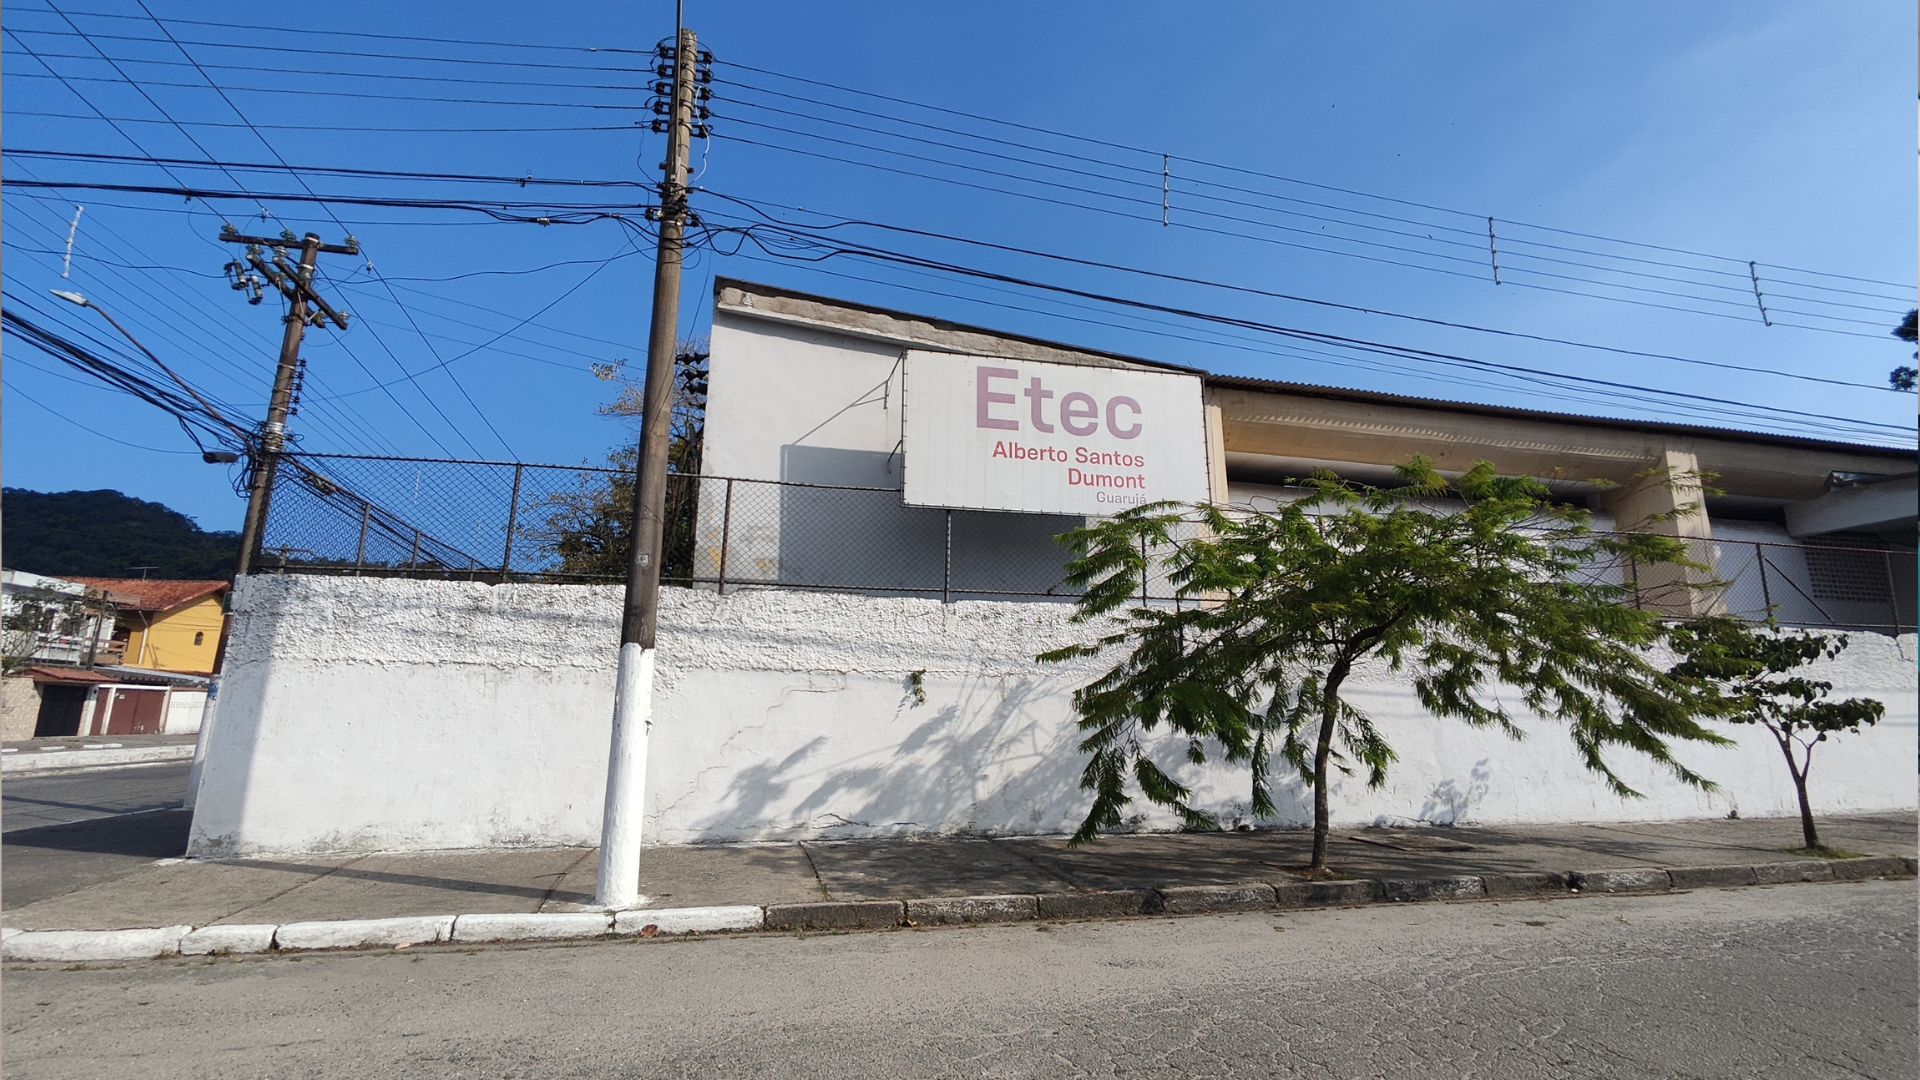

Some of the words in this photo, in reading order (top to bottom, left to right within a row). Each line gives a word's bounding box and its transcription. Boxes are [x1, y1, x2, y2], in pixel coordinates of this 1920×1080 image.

[976, 366, 1143, 440] Etec
[992, 440, 1068, 462] Alberto
[1075, 447, 1145, 468] Santos
[1068, 468, 1146, 489] Dumont
[1096, 491, 1147, 506] Guarujá
